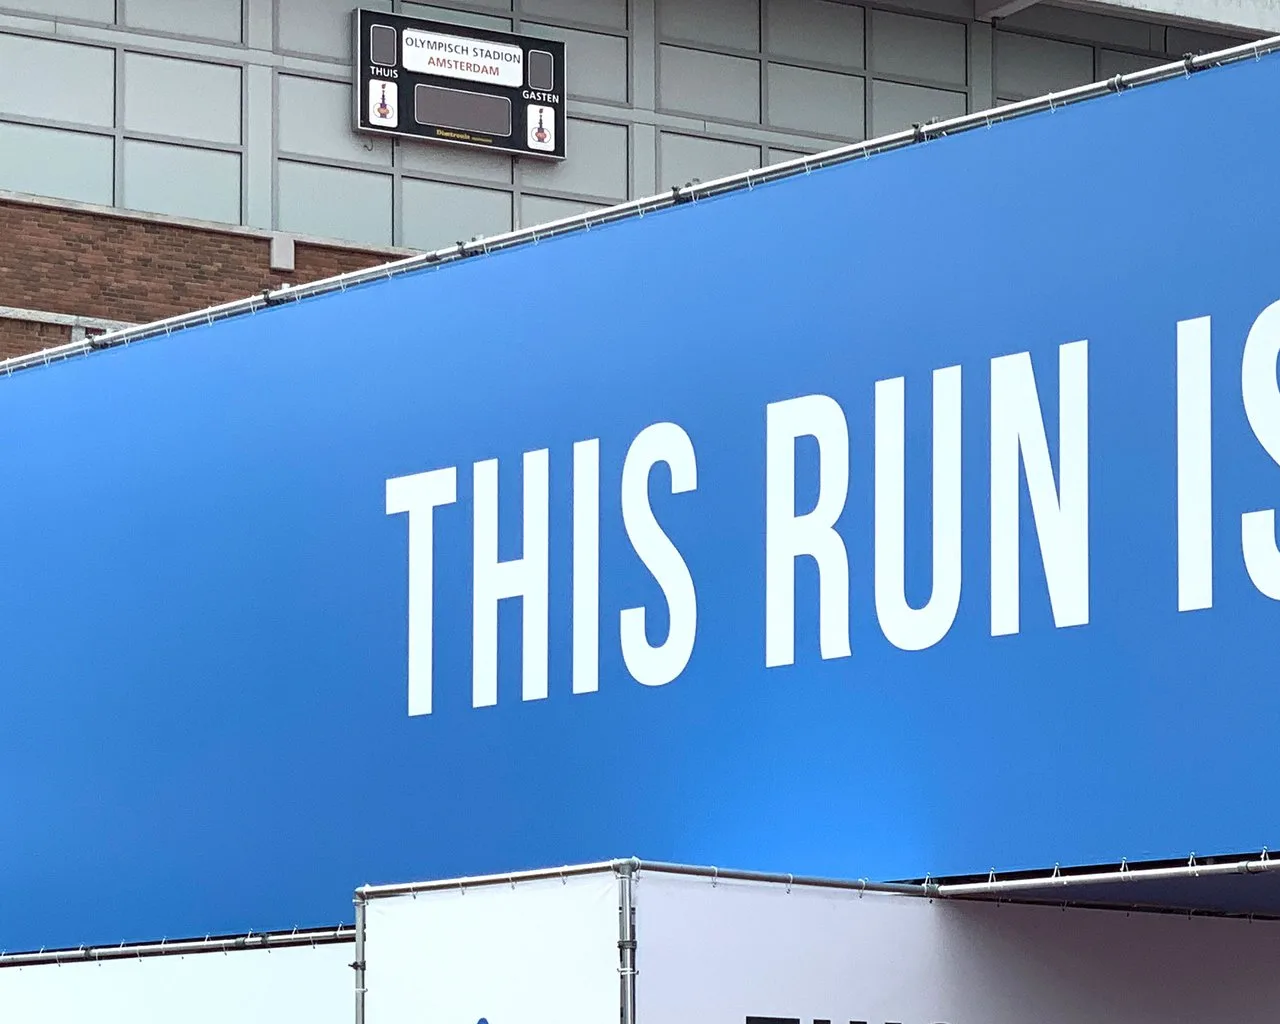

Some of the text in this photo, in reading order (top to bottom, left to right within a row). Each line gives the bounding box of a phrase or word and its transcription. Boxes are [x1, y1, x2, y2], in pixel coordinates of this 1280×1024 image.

[405, 36, 521, 64] OLYMPISCH STADION
[370, 66, 398, 78] THUIS
[428, 56, 500, 76] AMSTERDAM
[522, 90, 559, 104] GASTEN
[385, 422, 699, 717] THIS
[765, 339, 1090, 669] RUN
